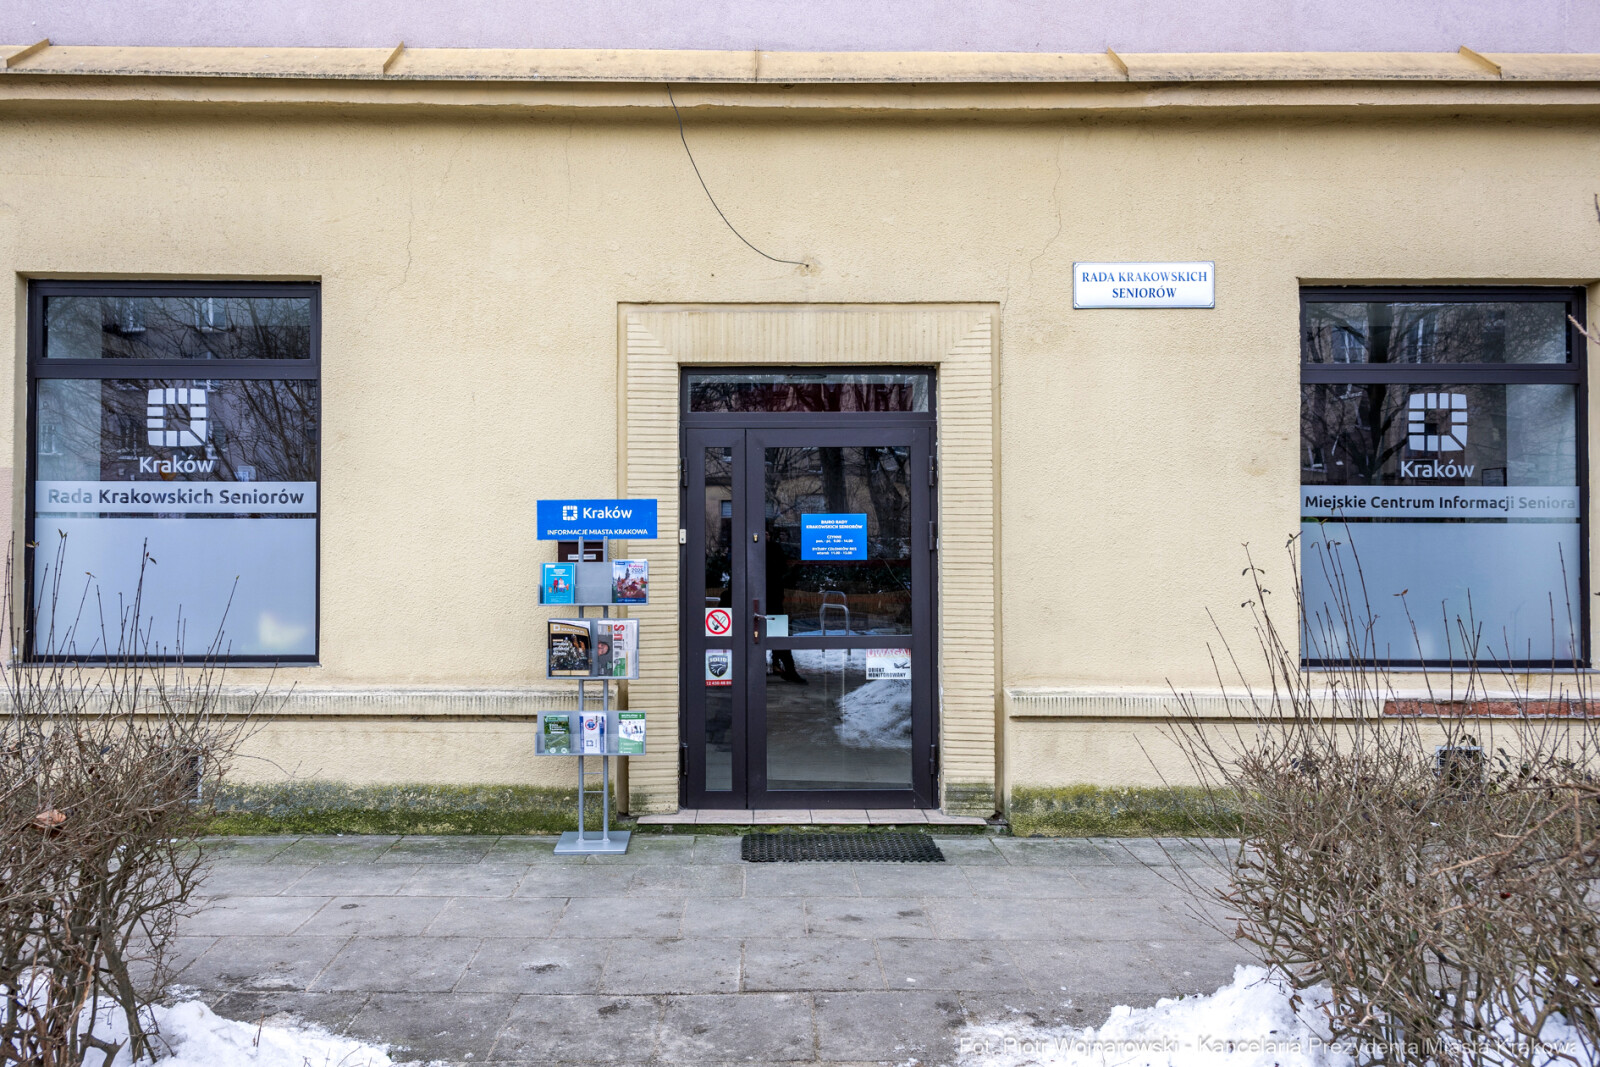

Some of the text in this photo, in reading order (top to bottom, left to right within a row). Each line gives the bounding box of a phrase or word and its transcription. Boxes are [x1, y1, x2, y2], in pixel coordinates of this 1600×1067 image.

[1082, 271, 1208, 282] RADA KRAKOWSKICH
[1112, 285, 1177, 299] SENIORÓW
[139, 454, 214, 473] Kraków
[1400, 459, 1475, 479] Kraków
[48, 487, 305, 504] Rada Krakowskich Seniorów
[1305, 495, 1576, 512] Miejskie Centrum Informacji Seniora
[582, 506, 633, 519] Kraków
